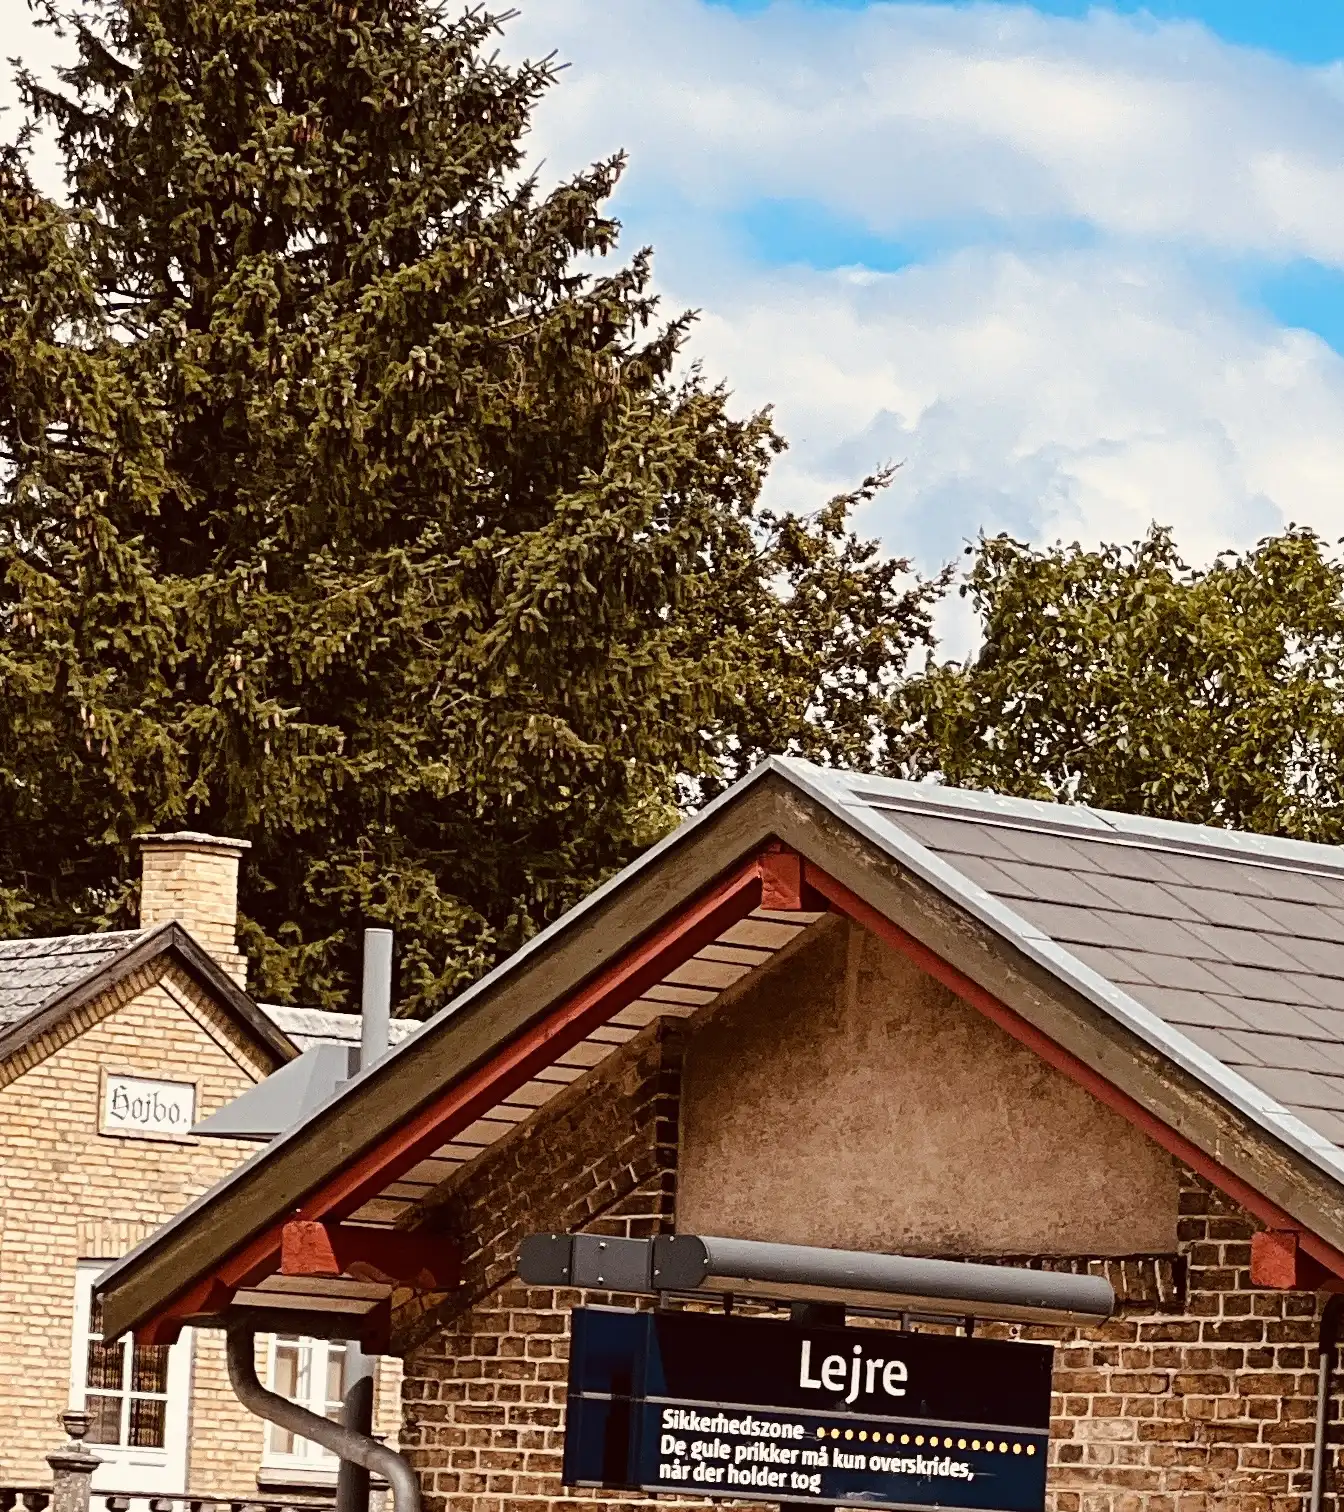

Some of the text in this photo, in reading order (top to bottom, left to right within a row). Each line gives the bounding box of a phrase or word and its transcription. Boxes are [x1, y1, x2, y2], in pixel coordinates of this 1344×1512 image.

[800, 1340, 908, 1404] Lejre
[662, 1408, 805, 1440] Sikkerhedszone
[659, 1460, 821, 1493] når der holder tog
[660, 1434, 975, 1481] De gule prikker må kun overskrides,
